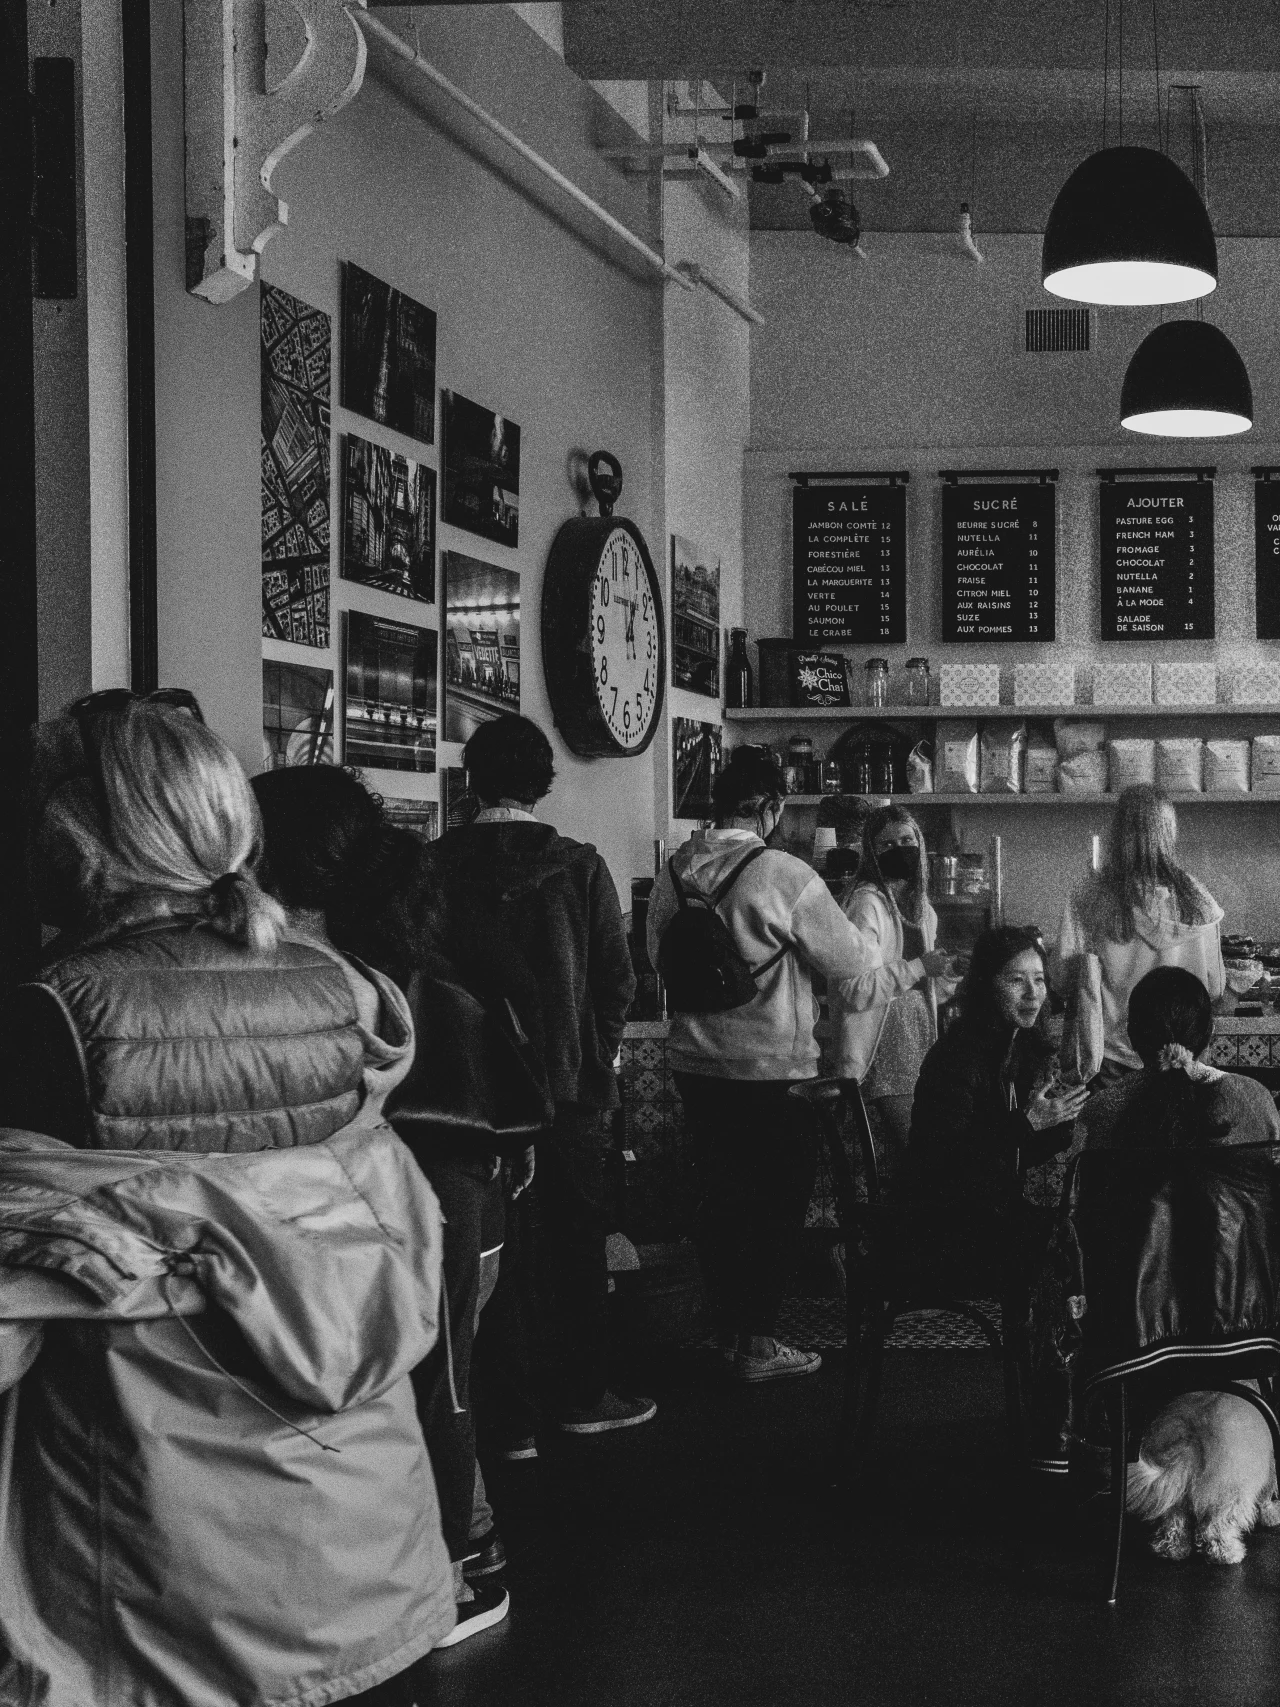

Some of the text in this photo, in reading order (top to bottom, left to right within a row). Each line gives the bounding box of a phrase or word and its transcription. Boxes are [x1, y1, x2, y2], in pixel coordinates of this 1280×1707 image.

[828, 496, 868, 511] SALÉ
[974, 497, 1017, 510] SUCRÉ
[1127, 498, 1184, 507] AJOUTER
[1116, 517, 1152, 525] PASTURE
[958, 547, 994, 556] AURÉLIA
[643, 592, 649, 622] 2
[597, 614, 605, 645] 9
[600, 655, 608, 686] 8
[643, 667, 650, 696] 4
[816, 667, 843, 679] Chico
[818, 678, 844, 692] Chai
[610, 686, 618, 717] 7
[636, 692, 643, 722] 5
[623, 700, 631, 730] 6
